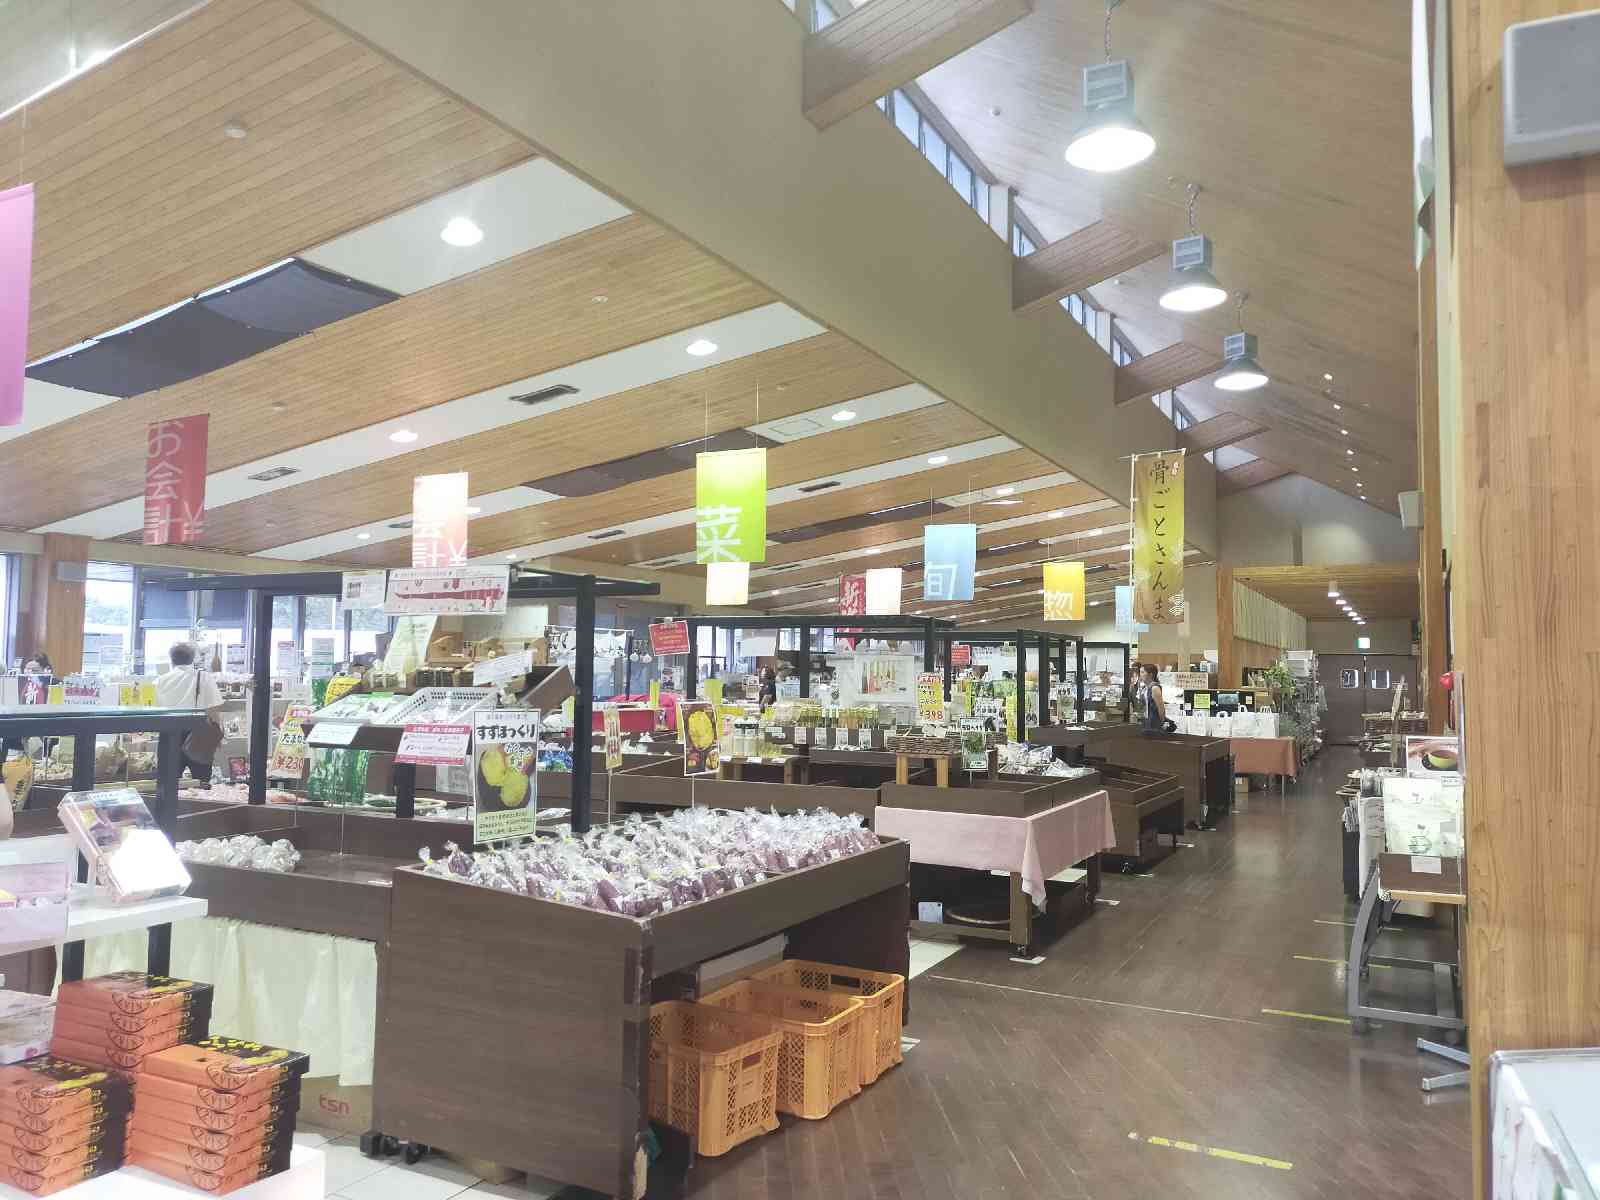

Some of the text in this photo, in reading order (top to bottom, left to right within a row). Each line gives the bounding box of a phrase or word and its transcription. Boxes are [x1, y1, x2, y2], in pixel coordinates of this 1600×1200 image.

[1151, 459, 1169, 620] 骨ごとさんま
[475, 724, 536, 740] すずほっくり
